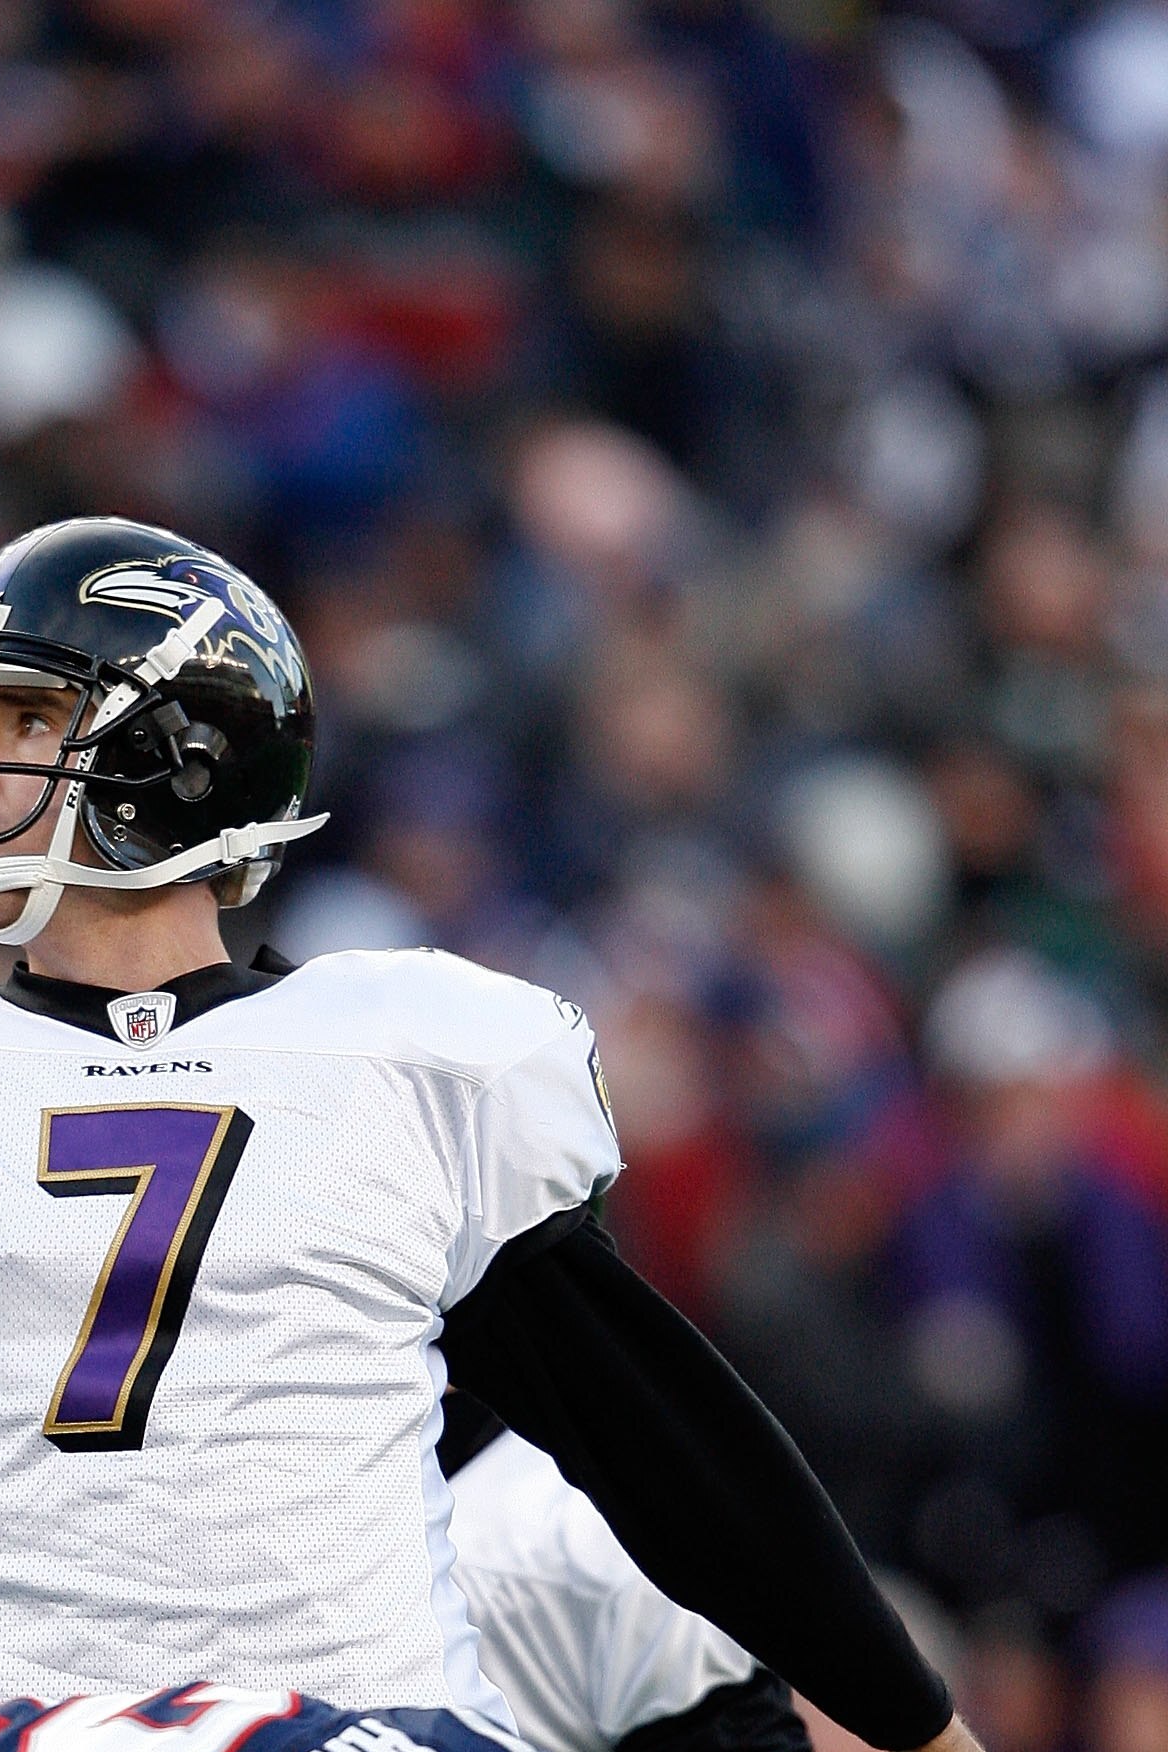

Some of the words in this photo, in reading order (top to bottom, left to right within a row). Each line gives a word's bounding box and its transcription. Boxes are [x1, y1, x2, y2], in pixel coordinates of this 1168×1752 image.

[131, 1020, 156, 1038] NFL
[82, 1061, 213, 1077] RAVENS
[37, 1101, 255, 1453] 7
